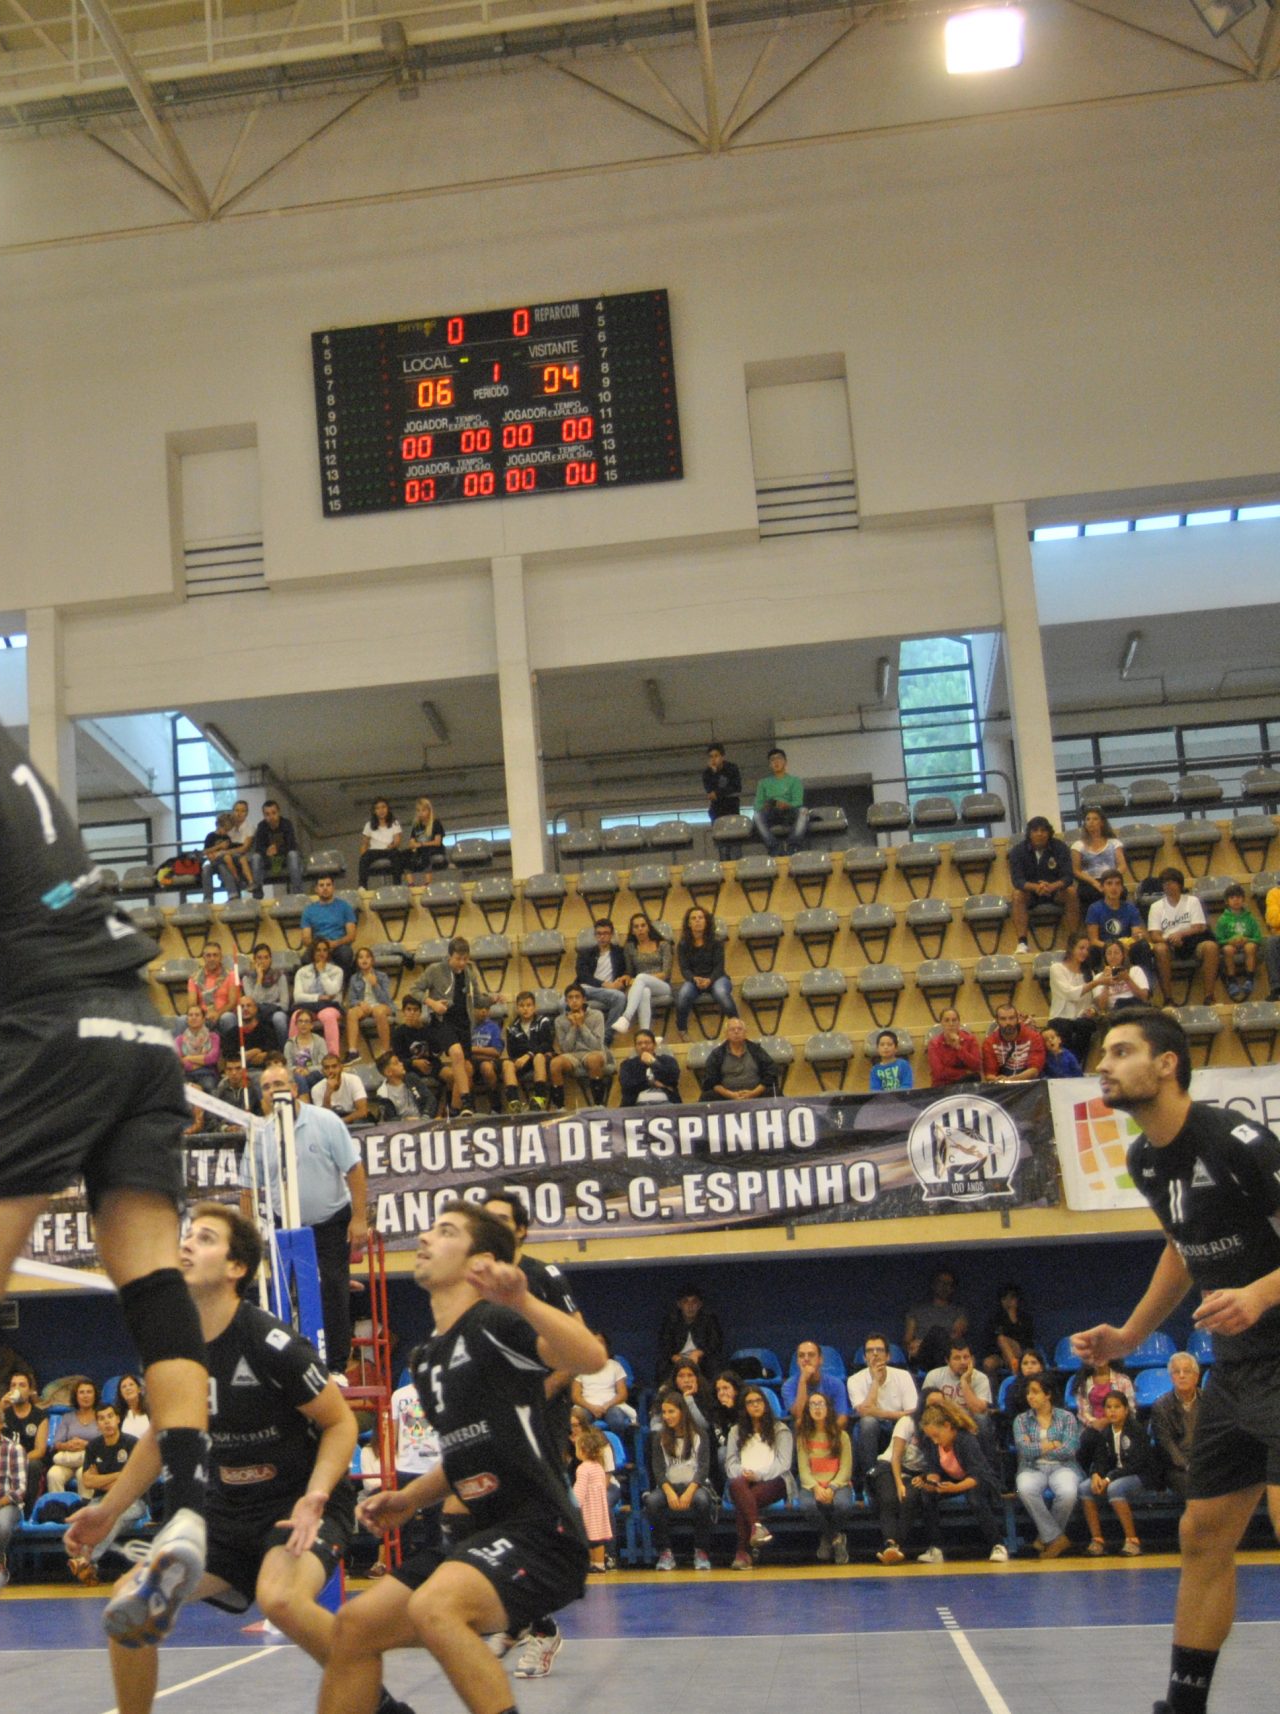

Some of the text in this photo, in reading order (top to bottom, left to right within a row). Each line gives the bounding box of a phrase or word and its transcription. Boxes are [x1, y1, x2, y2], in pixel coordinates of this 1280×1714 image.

[595, 302, 604, 312] 4
[534, 304, 580, 322] REPARCOM
[512, 306, 530, 337] 0
[597, 316, 606, 327] 5
[447, 315, 464, 344] 0
[322, 335, 330, 345] 4
[598, 332, 606, 342] 6
[324, 349, 332, 360] 5
[528, 340, 579, 358] VISITANTE
[600, 348, 608, 358] 7
[324, 364, 332, 375] 6
[403, 356, 453, 373] LOCAL
[601, 362, 610, 374] 8
[492, 361, 501, 383] 1
[326, 380, 334, 390] 7
[602, 377, 610, 388] 9
[418, 377, 454, 408] 06
[598, 391, 612, 402] 10
[326, 395, 335, 406] 8
[554, 400, 581, 410] TEMPO
[328, 411, 336, 422] 9
[502, 408, 547, 422] JOGADOR
[600, 408, 612, 418] 11
[455, 414, 482, 424] TEMPO
[324, 426, 338, 436] 10
[404, 418, 449, 434] JOGADOR
[562, 416, 593, 442] 00
[601, 424, 613, 434] 12
[461, 428, 492, 454] 00
[503, 423, 534, 449] 00
[324, 439, 336, 450] 11
[402, 435, 432, 460] 00
[558, 444, 585, 454] TEMPO
[602, 439, 616, 450] 13
[325, 455, 336, 466] 12
[457, 457, 484, 467] TEMPO
[506, 451, 551, 466] JOGADOR
[603, 455, 616, 466] 14
[326, 470, 339, 480] 13
[406, 462, 450, 478] JOGADOR
[604, 470, 618, 481] 15
[464, 471, 494, 497] 00
[505, 466, 536, 492] 00
[328, 484, 340, 496] 14
[329, 500, 342, 511] 15
[558, 1120, 613, 1162] DE
[624, 1107, 817, 1158] ESPINHO
[575, 1180, 618, 1222] S.
[628, 1176, 670, 1218] C.
[682, 1160, 878, 1215] ESPINHO
[951, 1181, 985, 1193] 100 ANOS
[1169, 1179, 1185, 1223] 11
